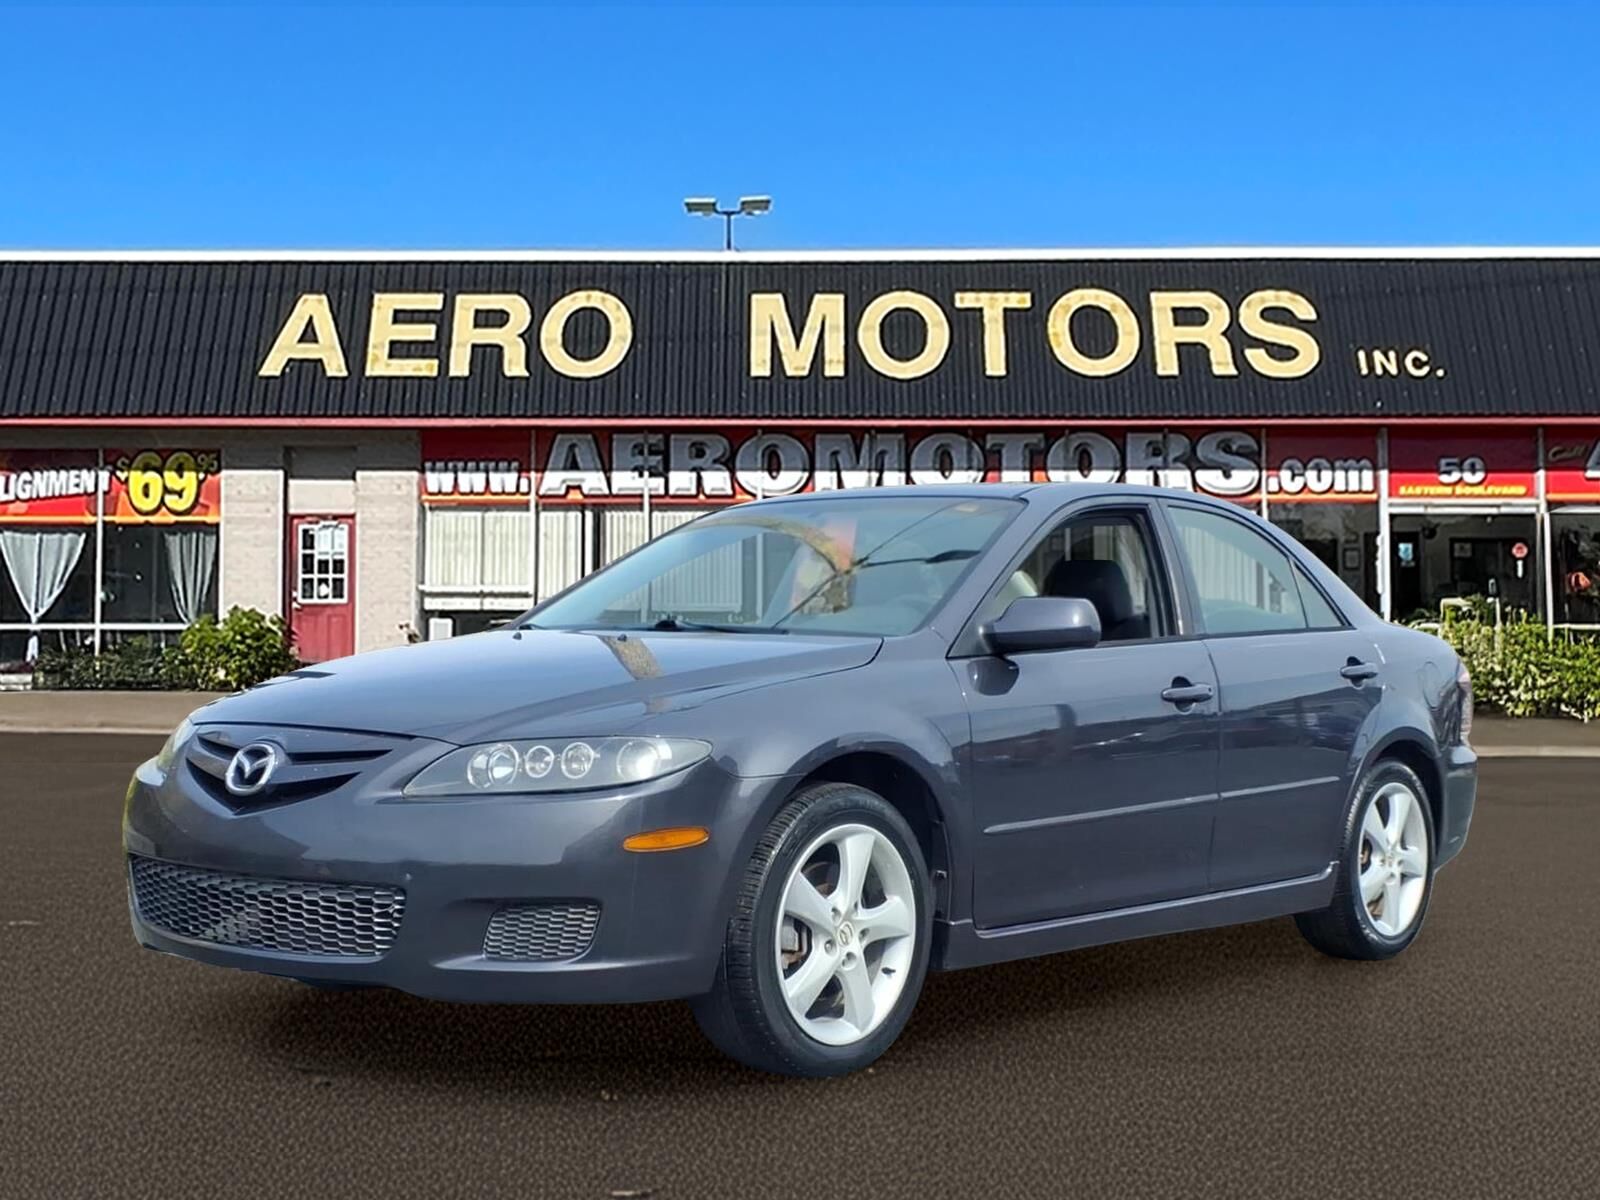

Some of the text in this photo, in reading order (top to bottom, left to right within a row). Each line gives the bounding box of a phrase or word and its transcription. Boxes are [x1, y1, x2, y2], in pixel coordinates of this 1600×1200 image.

[258, 288, 1447, 379] AERO MOTORS INC.
[1438, 457, 1486, 484] 50
